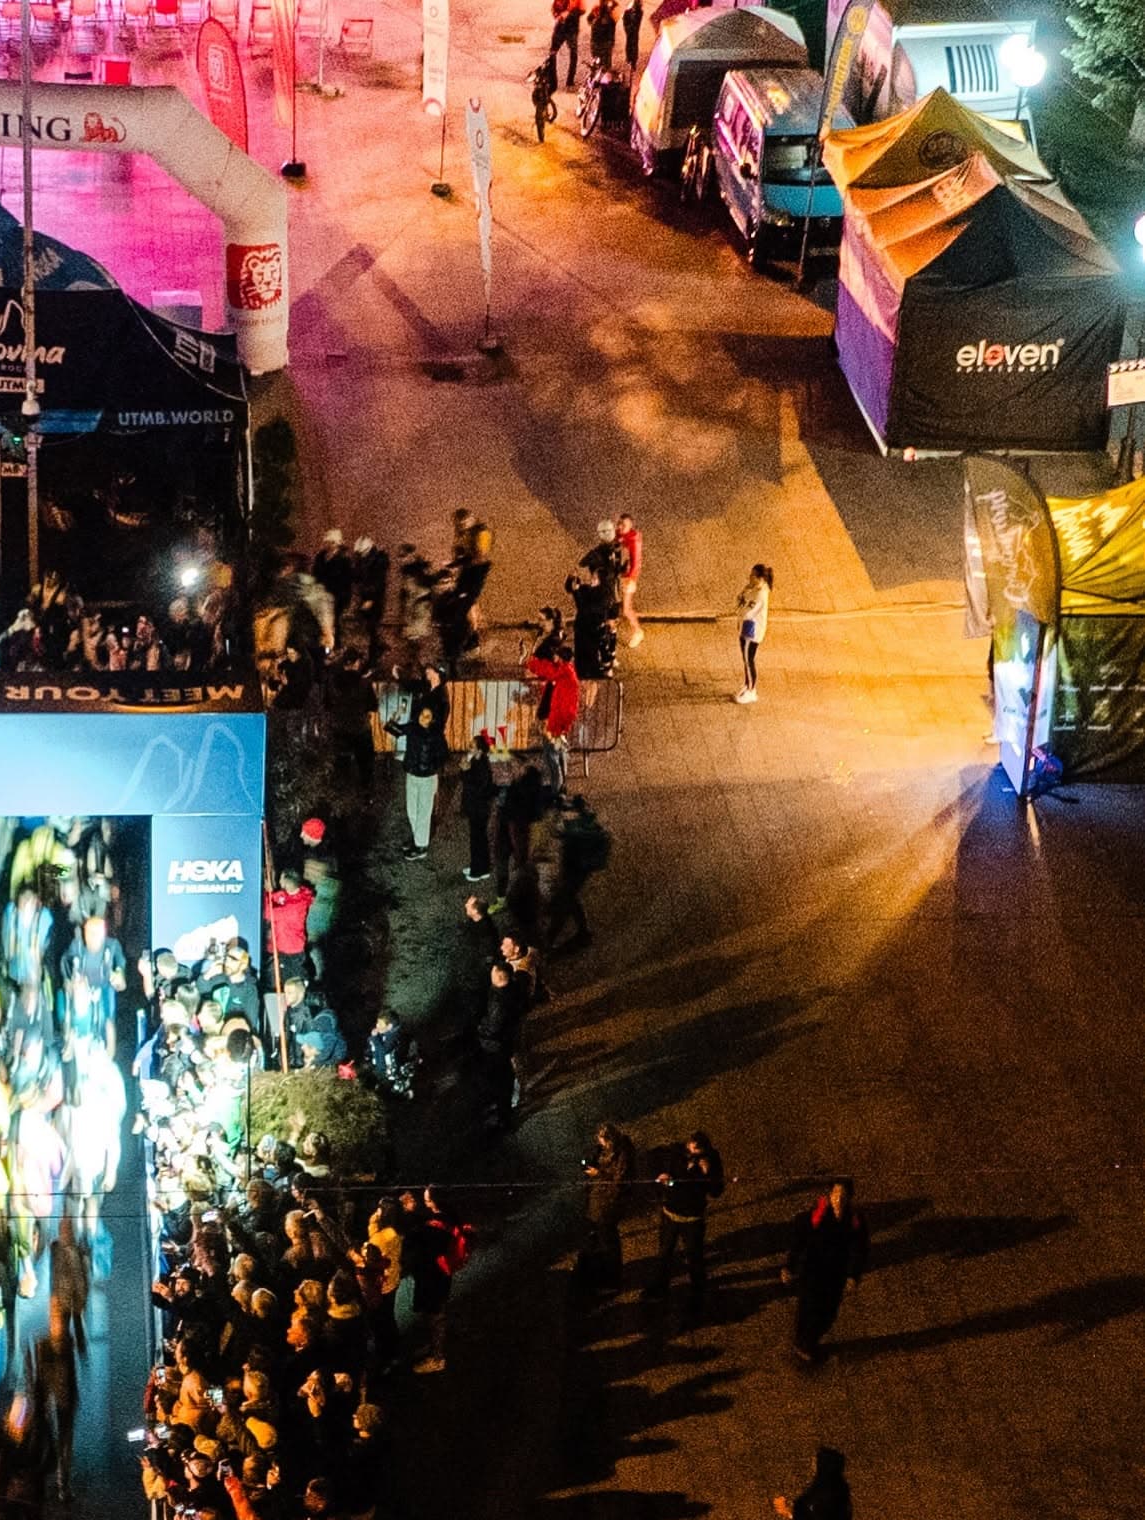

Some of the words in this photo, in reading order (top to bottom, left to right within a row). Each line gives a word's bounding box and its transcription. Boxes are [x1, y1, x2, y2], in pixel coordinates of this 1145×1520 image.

[1, 113, 72, 141] ING
[956, 339, 1060, 367] eleven
[0, 365, 33, 373] ROC
[118, 410, 234, 426] UTMB.WORLD
[6, 685, 124, 702] YOUR
[144, 685, 244, 702] MEET
[167, 859, 245, 882] HOKA
